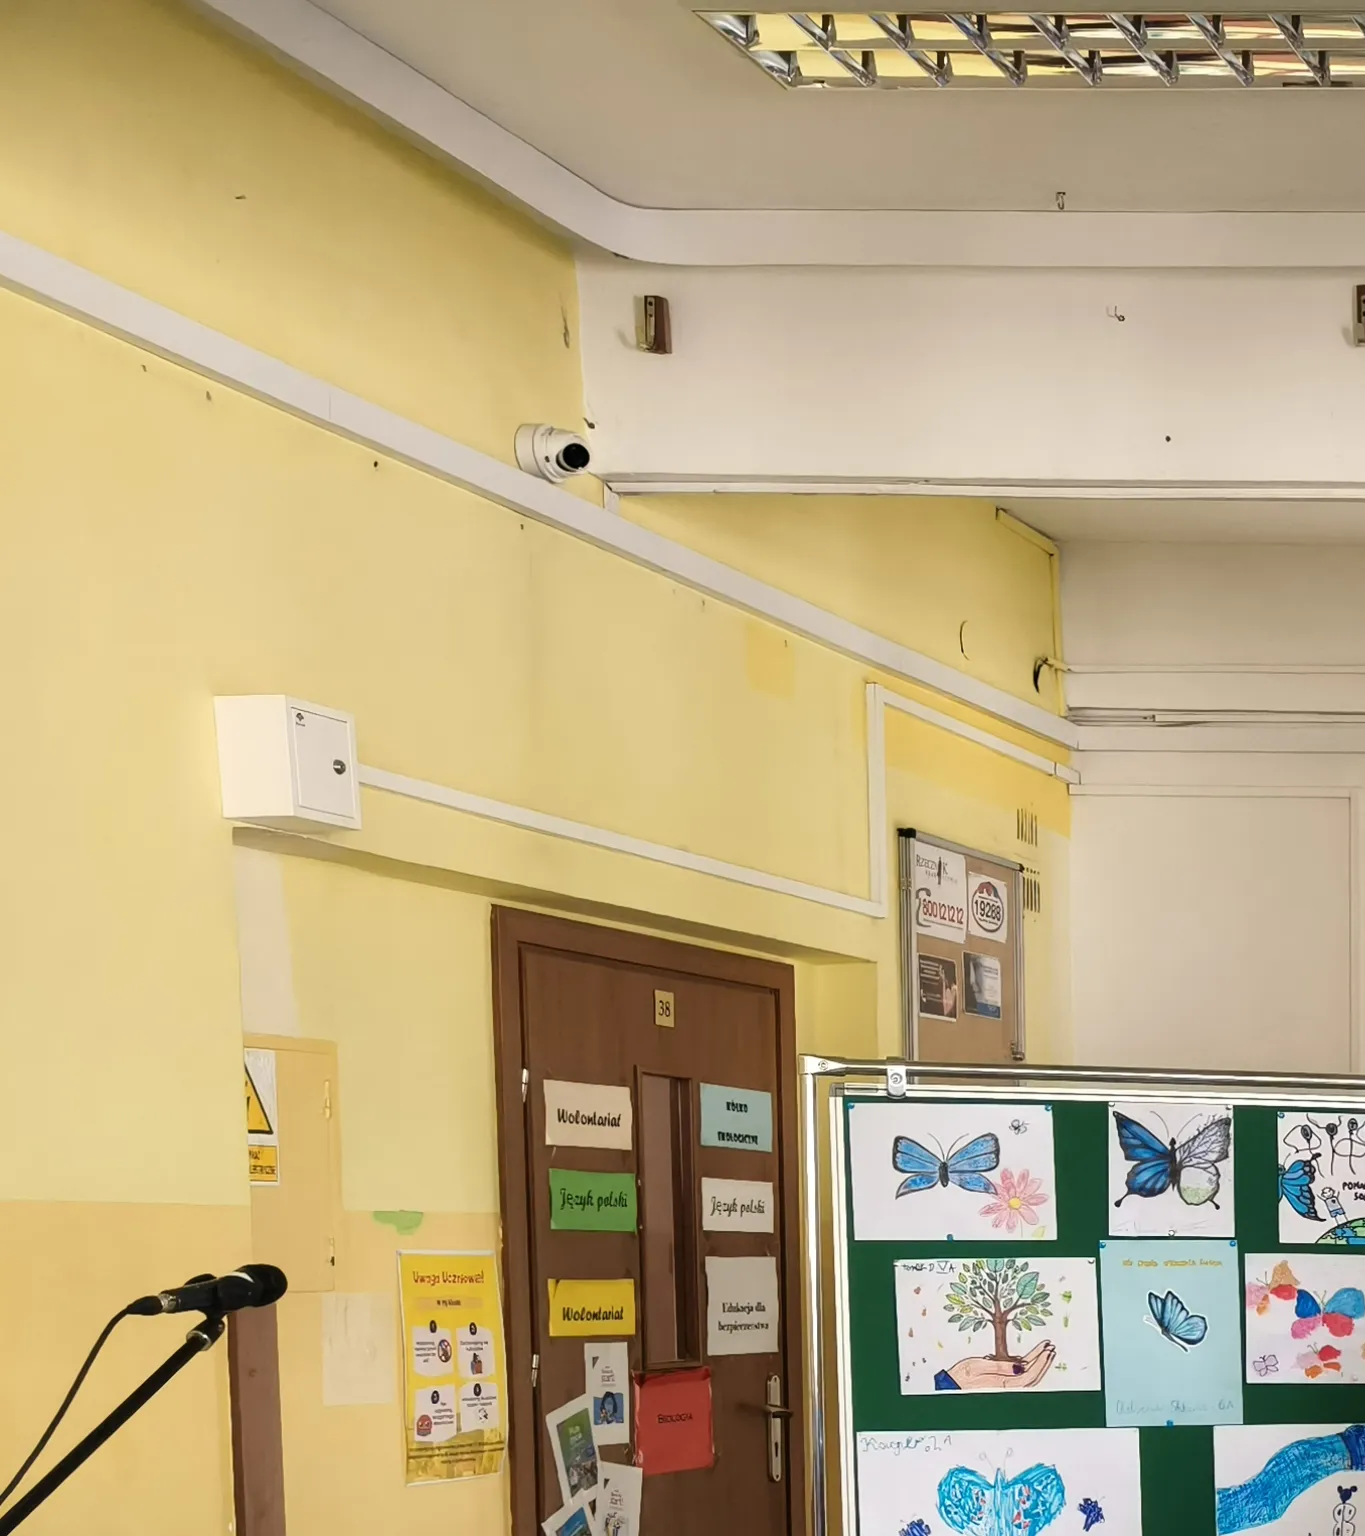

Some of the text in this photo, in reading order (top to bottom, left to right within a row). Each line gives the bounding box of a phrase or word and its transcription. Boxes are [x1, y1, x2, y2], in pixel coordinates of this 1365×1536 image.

[658, 1000, 671, 1017] 38
[557, 1108, 622, 1128] Wolontariat
[560, 1188, 628, 1212] Język polski
[710, 1196, 765, 1217] Język polski
[562, 1306, 624, 1322] Wolontariat
